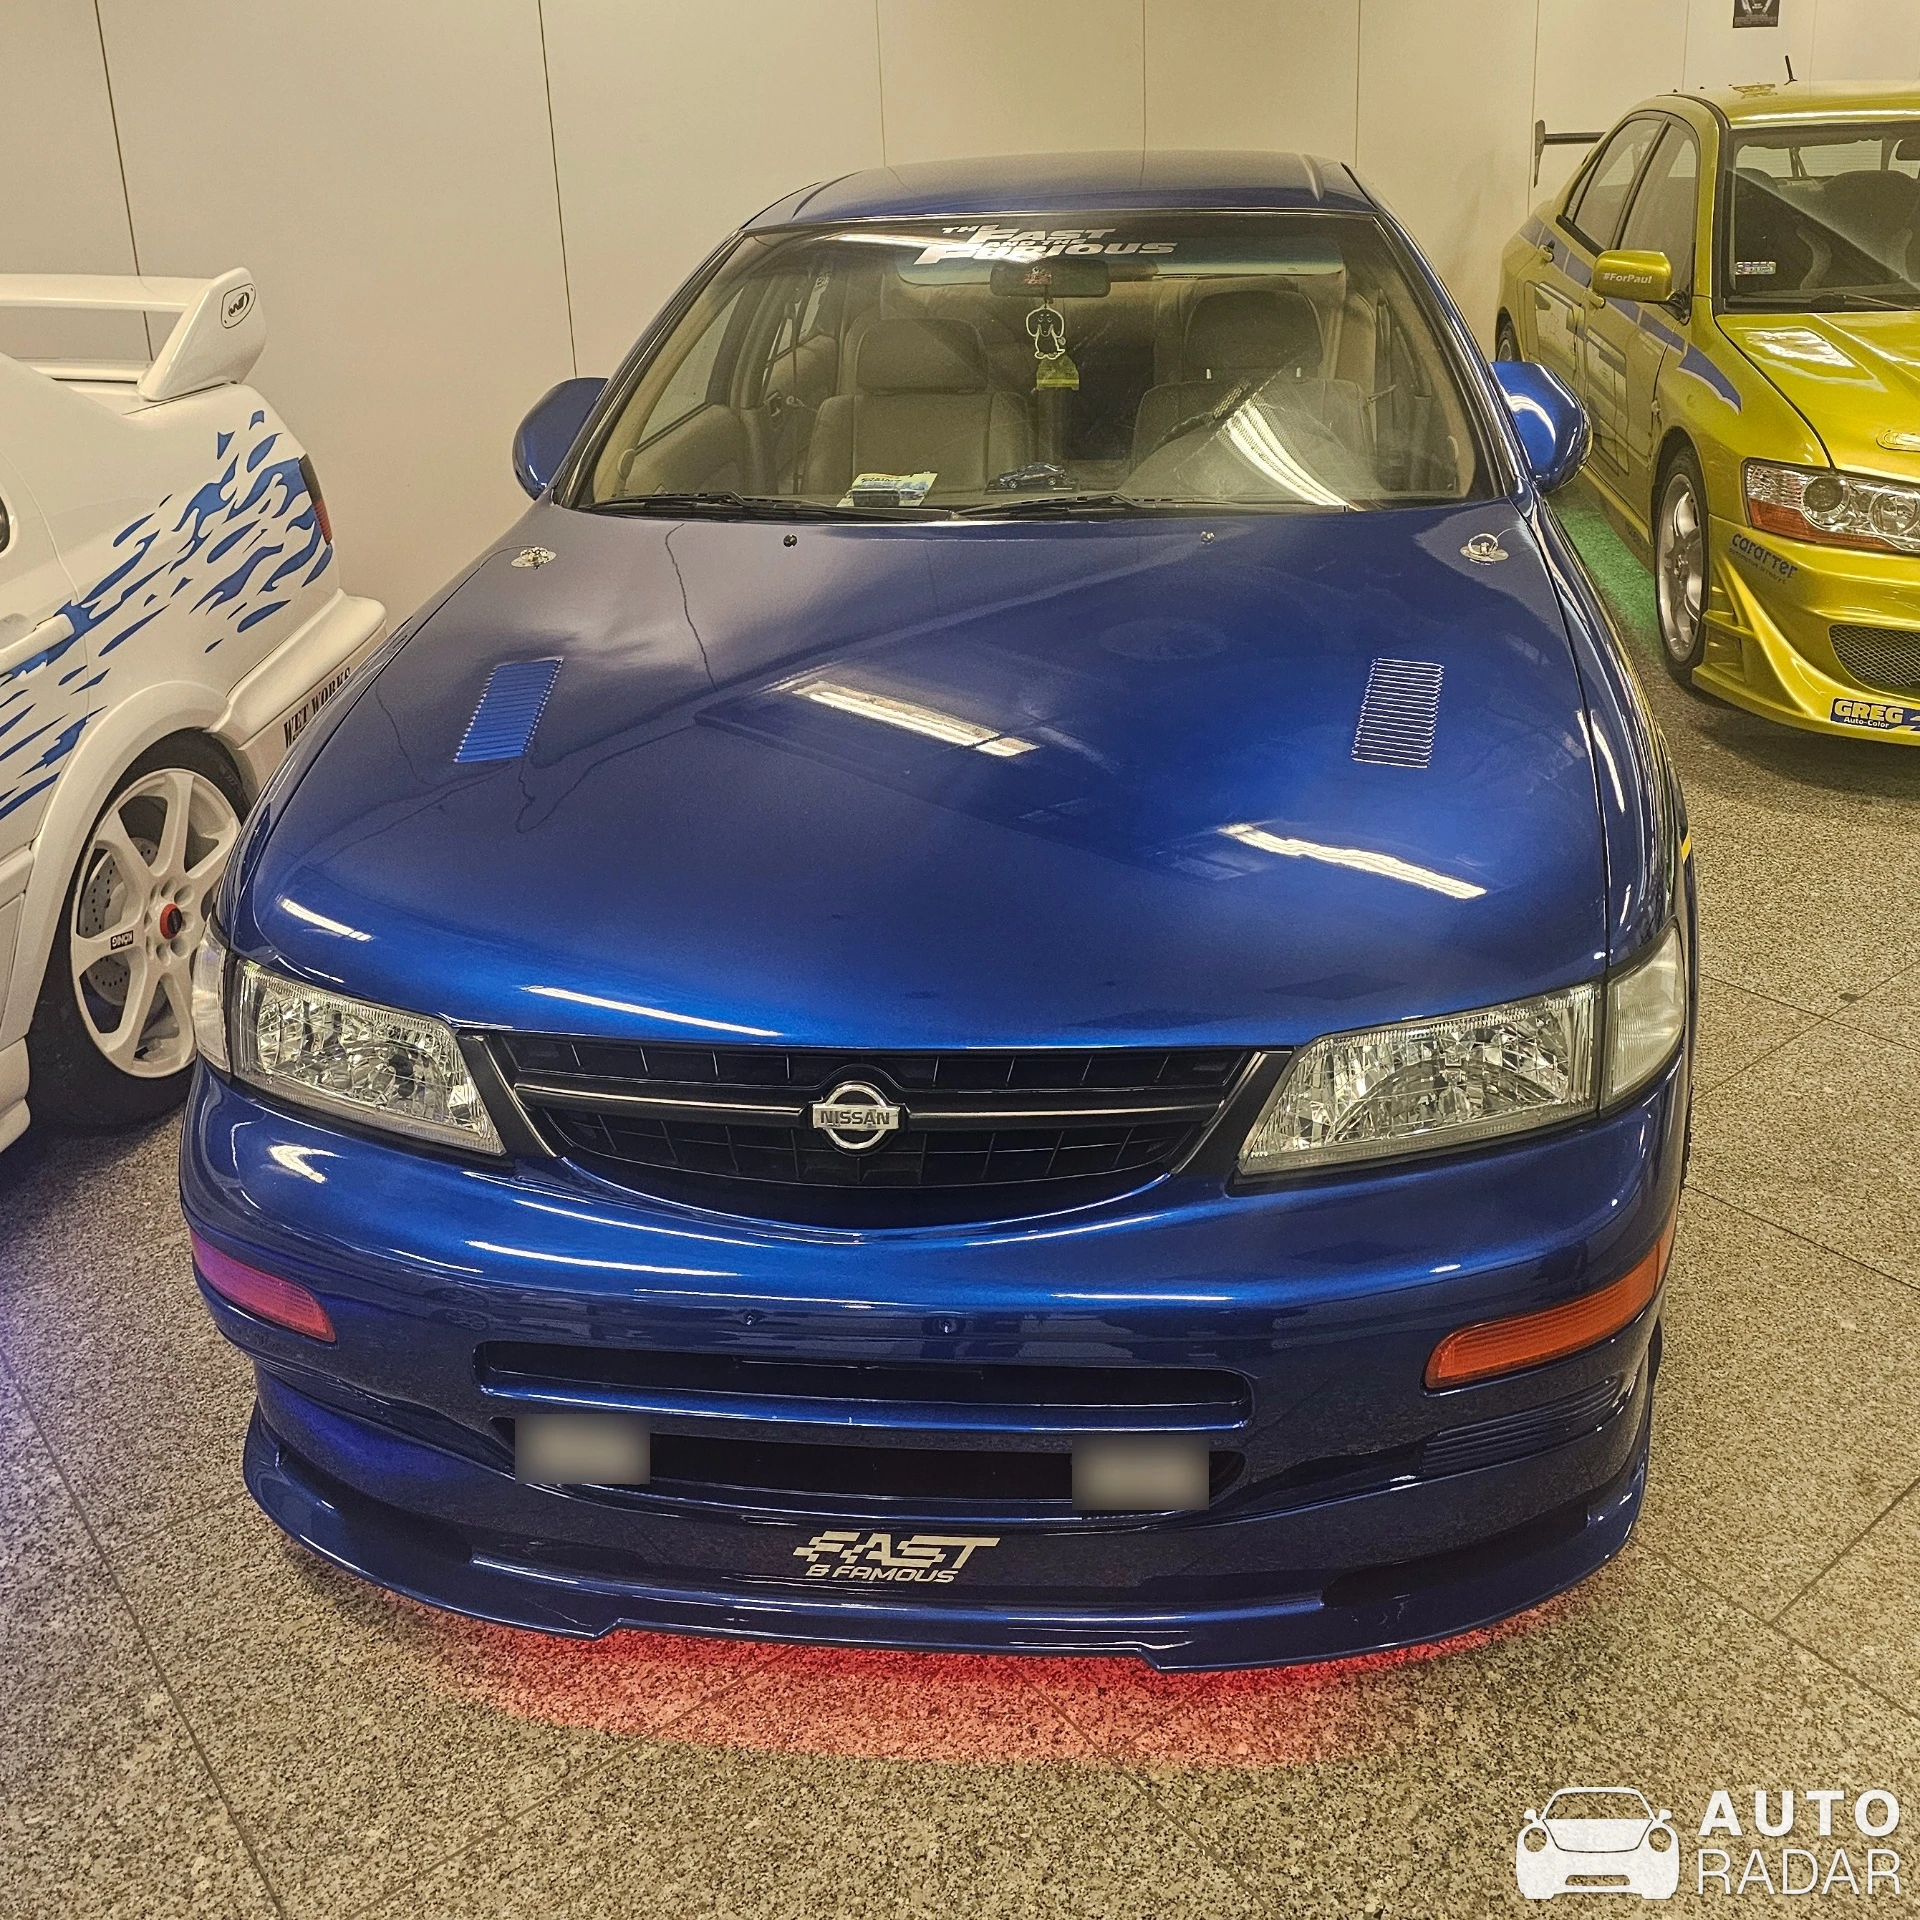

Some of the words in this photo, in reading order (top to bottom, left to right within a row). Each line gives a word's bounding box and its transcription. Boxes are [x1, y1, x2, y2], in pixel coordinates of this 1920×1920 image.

[941, 224, 999, 234] THE
[966, 228, 1117, 245] FAST
[982, 240, 1037, 248] AND
[914, 242, 1178, 265] FURIOUS
[1603, 272, 1653, 284] #ForPaul
[1833, 700, 1904, 724] GREG
[283, 703, 309, 749] WET
[1843, 716, 1890, 729] Auto-Color
[820, 1110, 891, 1126] NISSAN
[792, 1530, 1001, 1570] FAST
[805, 1564, 831, 1577] &
[831, 1564, 959, 1583] FAMOUS
